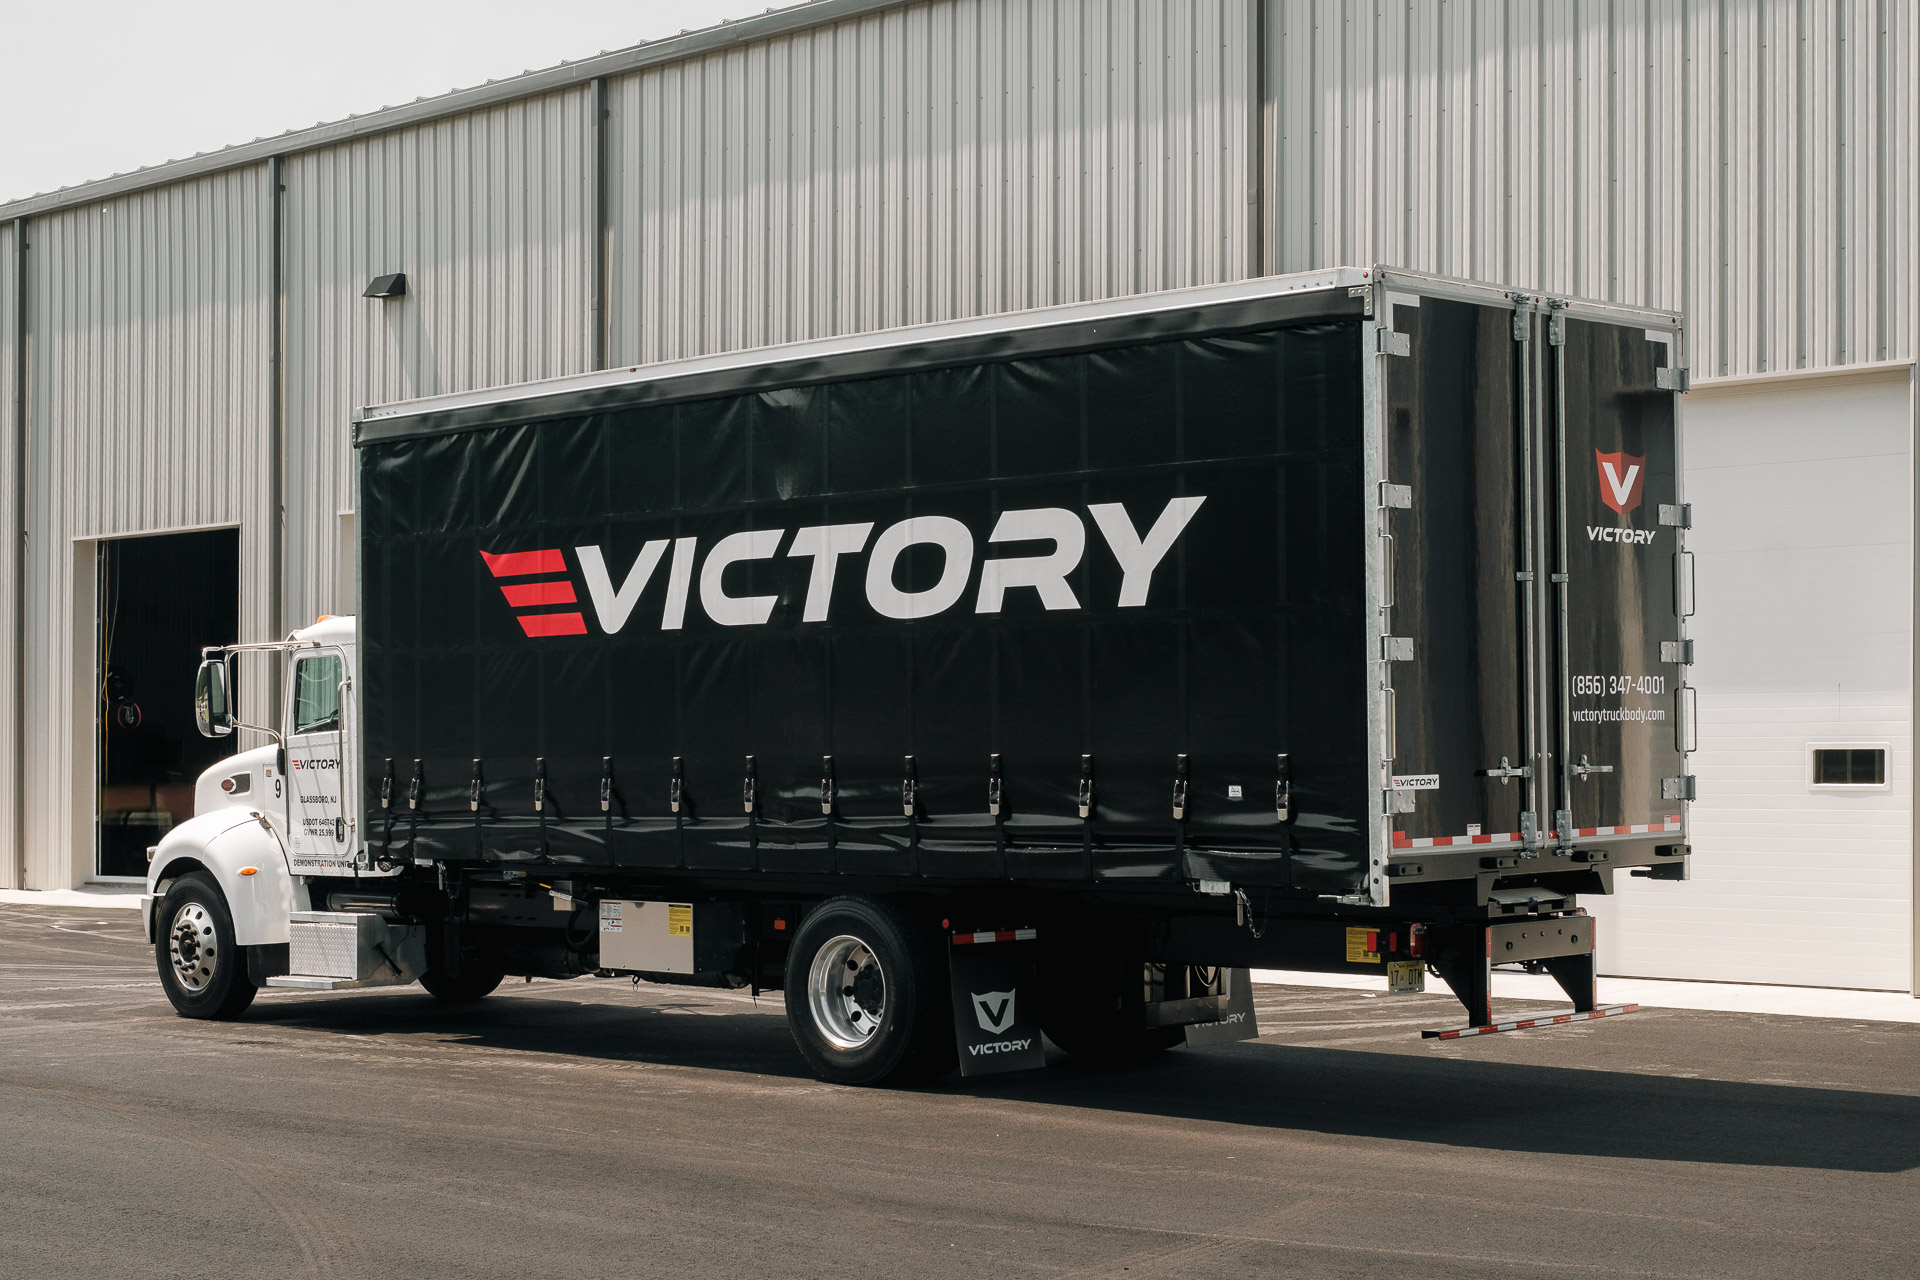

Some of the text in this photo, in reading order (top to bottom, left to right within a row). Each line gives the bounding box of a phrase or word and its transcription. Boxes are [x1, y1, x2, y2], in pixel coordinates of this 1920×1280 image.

[1602, 461, 1640, 506] V
[1586, 525, 1656, 545] VICTORY
[575, 495, 1207, 635] VICTORY
[1572, 675, 1665, 697] (856) 347-4001
[1572, 707, 1665, 724] victorytruckbody.com
[299, 759, 341, 770] VICTORY
[275, 778, 282, 799] 9
[1400, 778, 1438, 787] VICTORY
[300, 795, 337, 805] GLASSBORO, NJ
[302, 818, 318, 826] USDOT
[303, 828, 318, 836] GVWR
[293, 859, 336, 868] DEMONSTRATION
[1390, 968, 1422, 986] 17 DTM
[968, 1038, 1031, 1056] VICTORY
